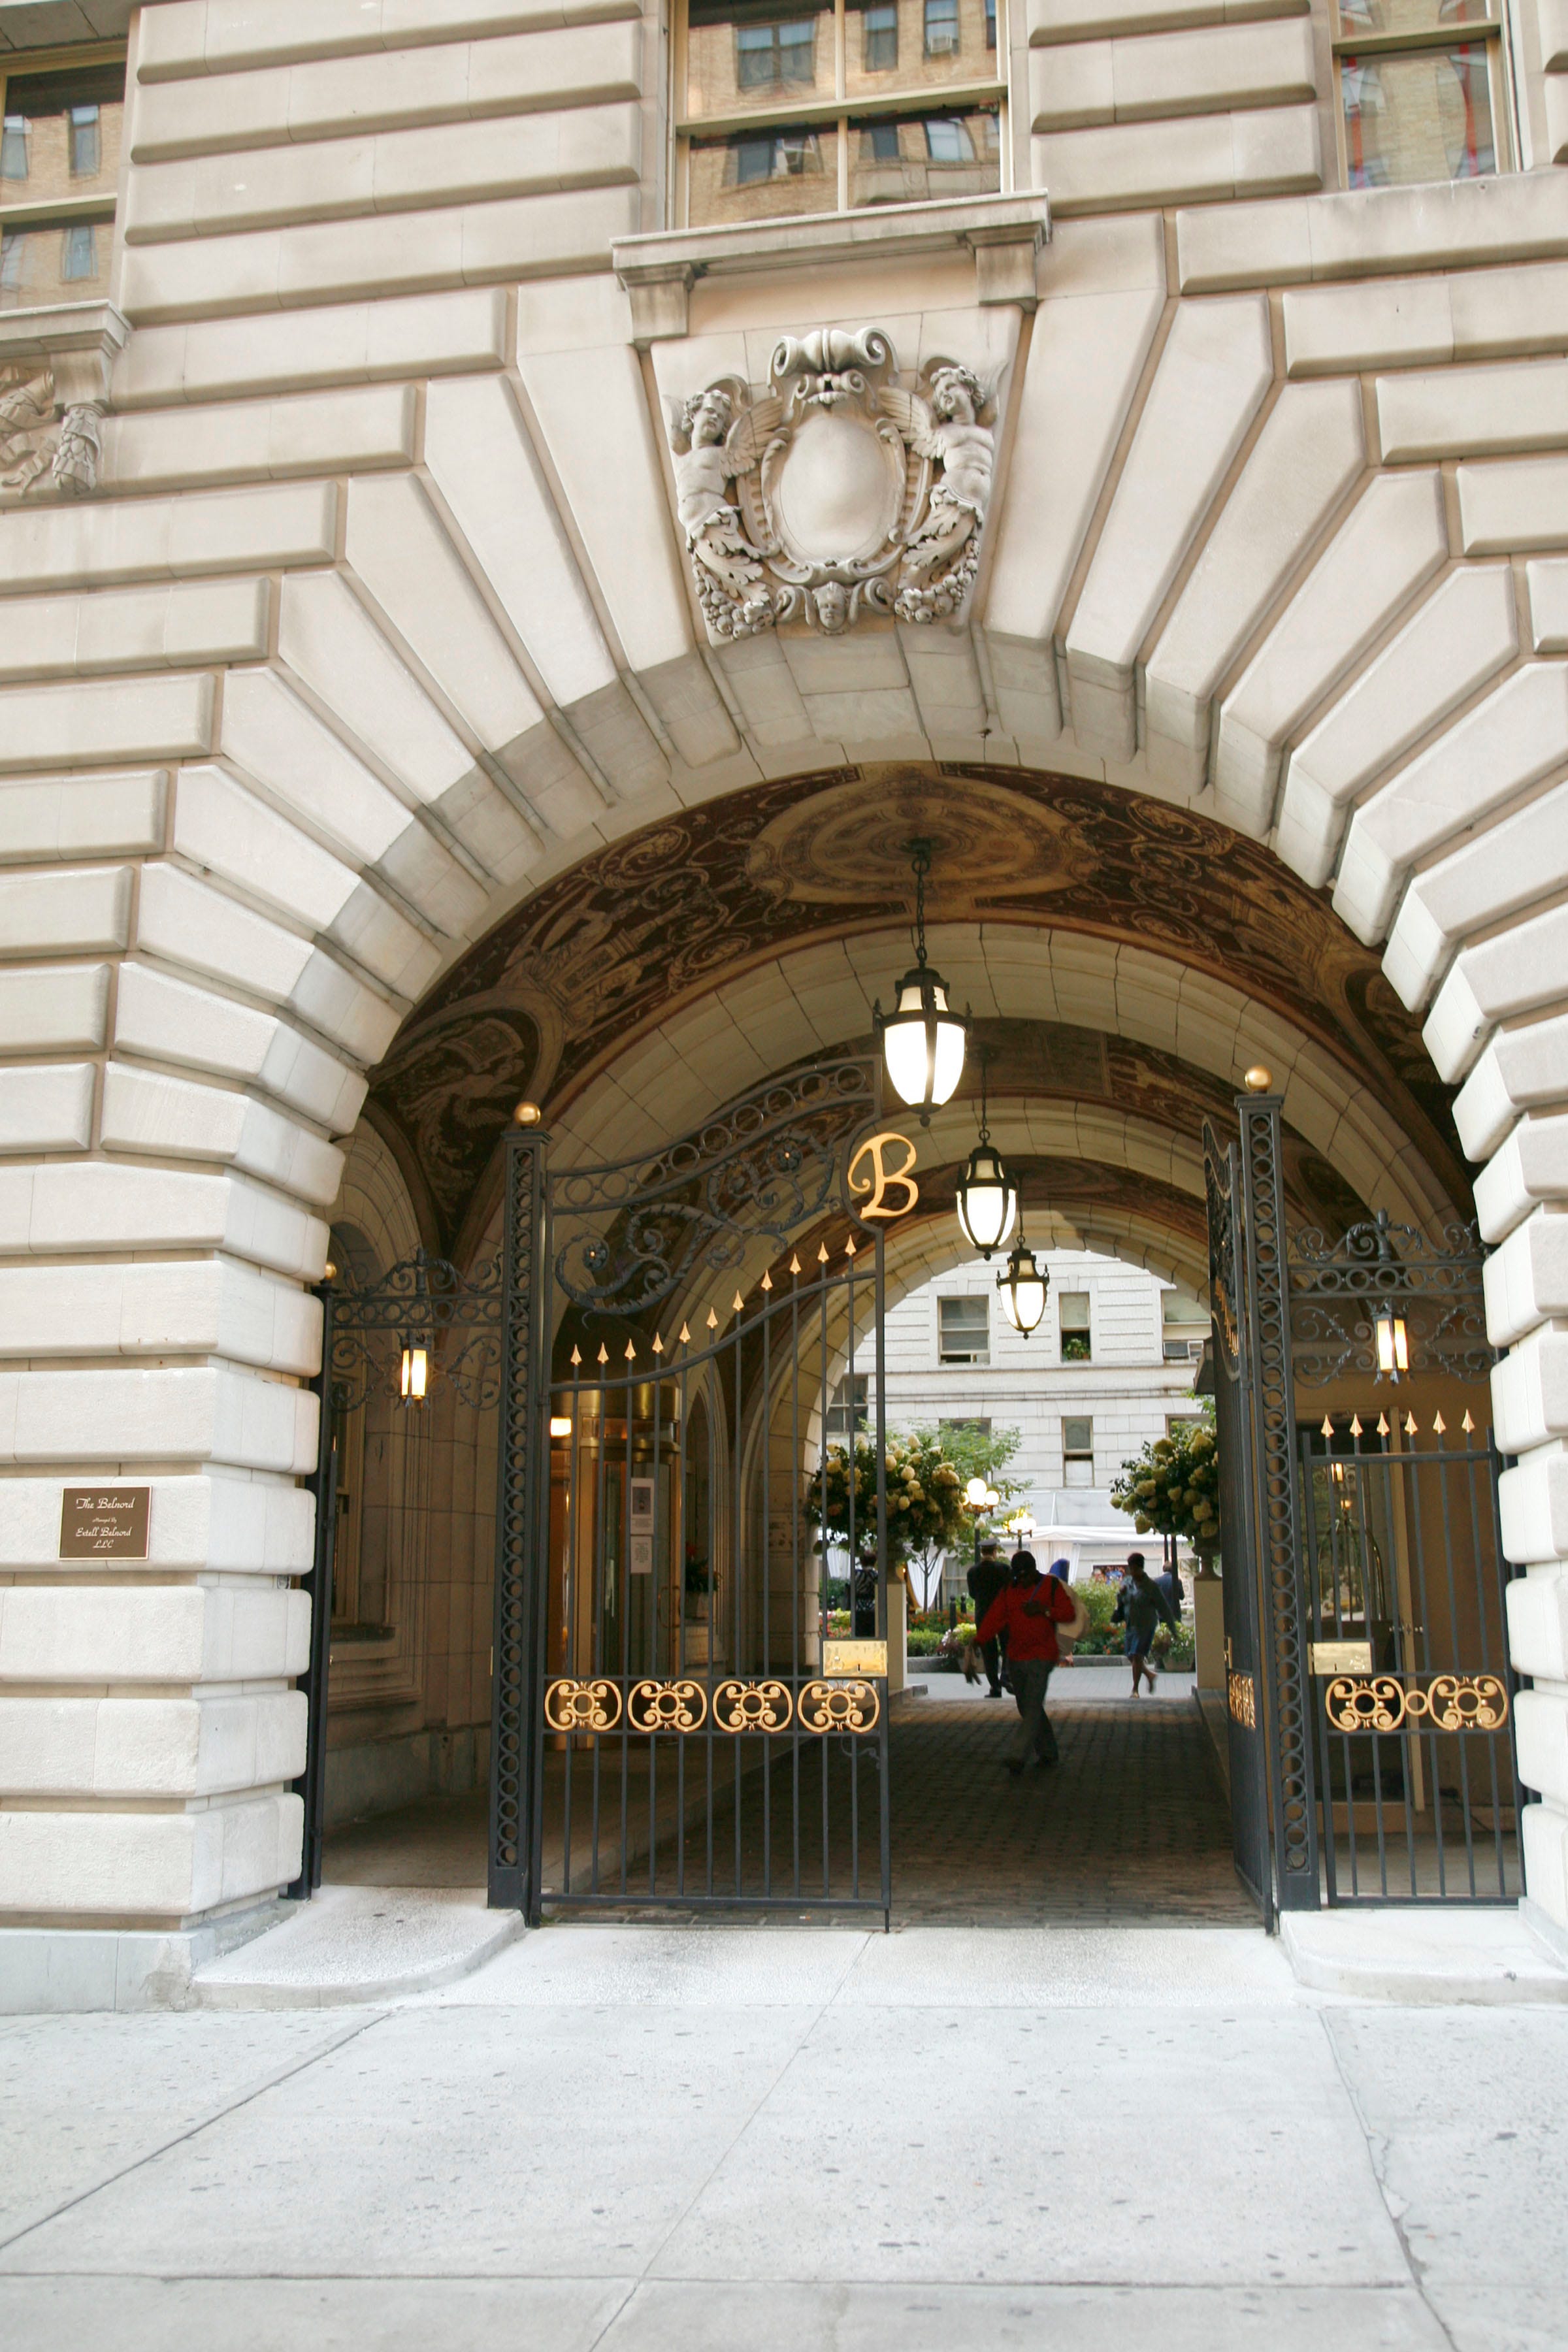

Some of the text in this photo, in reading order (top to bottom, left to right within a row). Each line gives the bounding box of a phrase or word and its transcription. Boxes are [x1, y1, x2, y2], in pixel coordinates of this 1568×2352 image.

[847, 1132, 919, 1220] B
[76, 1497, 135, 1509] The Belnord
[76, 1526, 132, 1537] Extell Belnord
[93, 1539, 114, 1548] LLC
